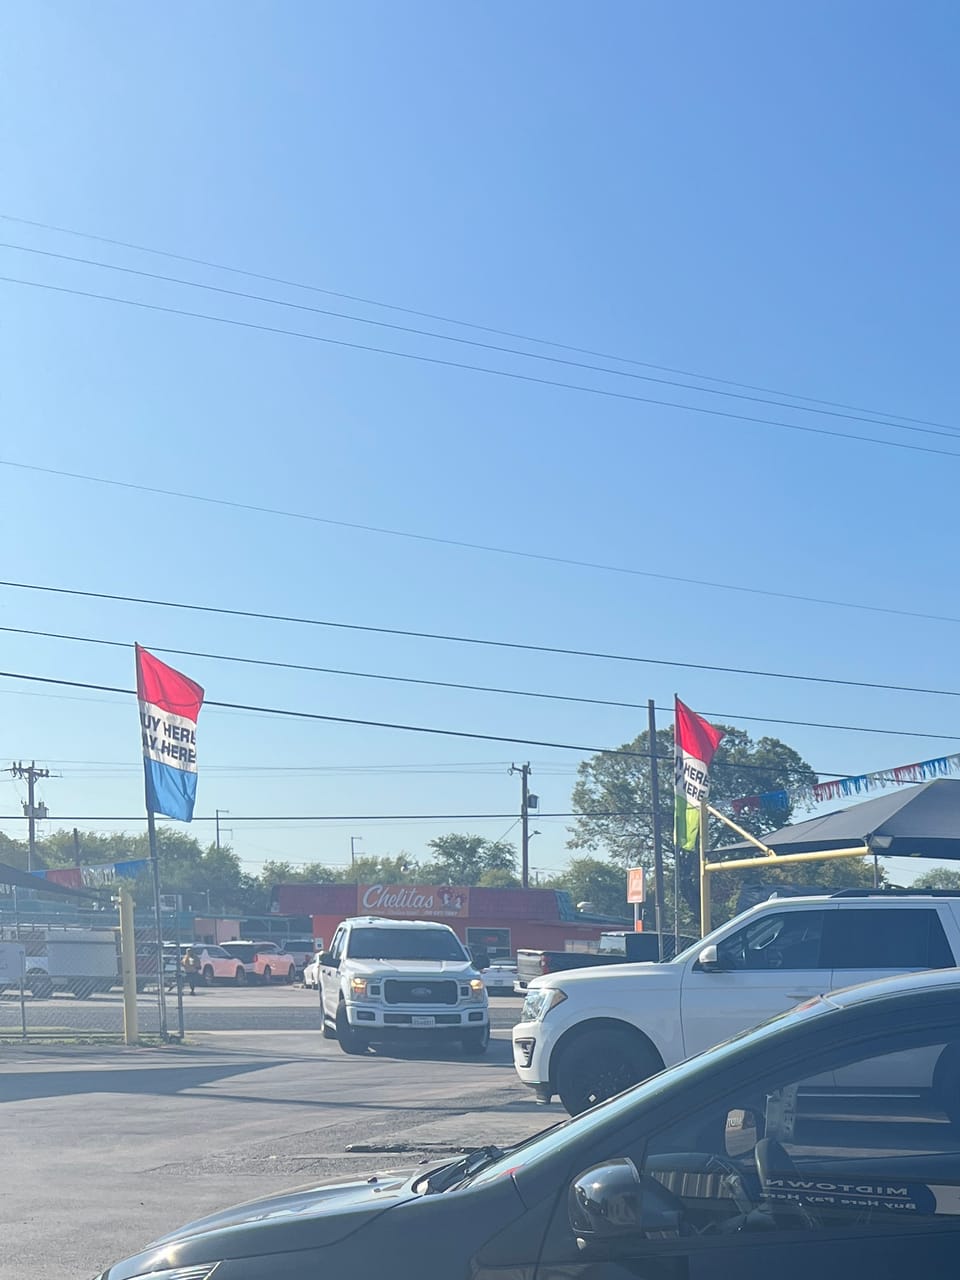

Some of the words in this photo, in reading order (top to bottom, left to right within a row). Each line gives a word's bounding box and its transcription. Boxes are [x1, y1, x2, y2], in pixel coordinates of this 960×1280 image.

[140, 711, 161, 731] UY
[161, 739, 196, 763] HERE
[363, 884, 434, 909] Chelitas
